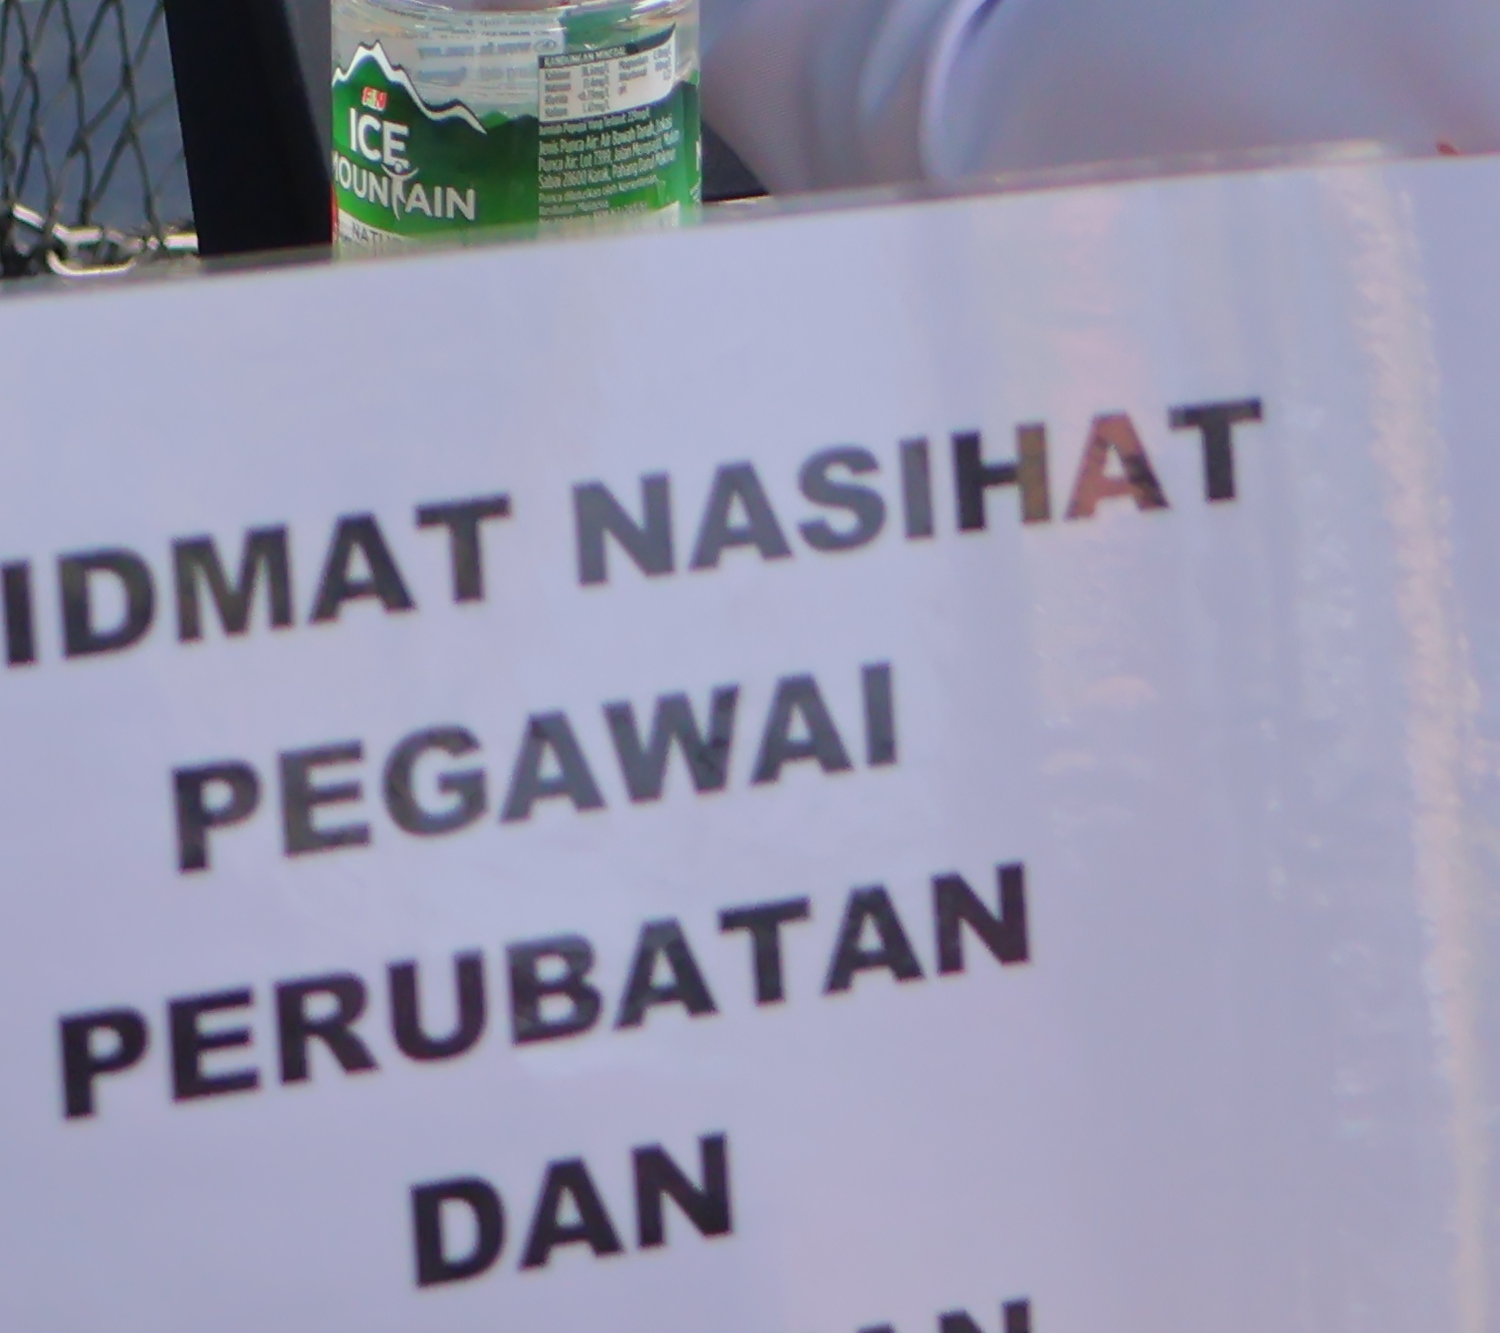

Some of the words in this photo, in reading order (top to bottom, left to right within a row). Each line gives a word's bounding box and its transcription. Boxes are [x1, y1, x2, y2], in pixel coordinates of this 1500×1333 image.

[349, 107, 411, 169] ICE
[570, 398, 1266, 588] NASIHAT
[170, 660, 899, 875] PEGAWAI
[58, 862, 1032, 1121] PERUBATAN
[411, 1132, 733, 1289] DAN
